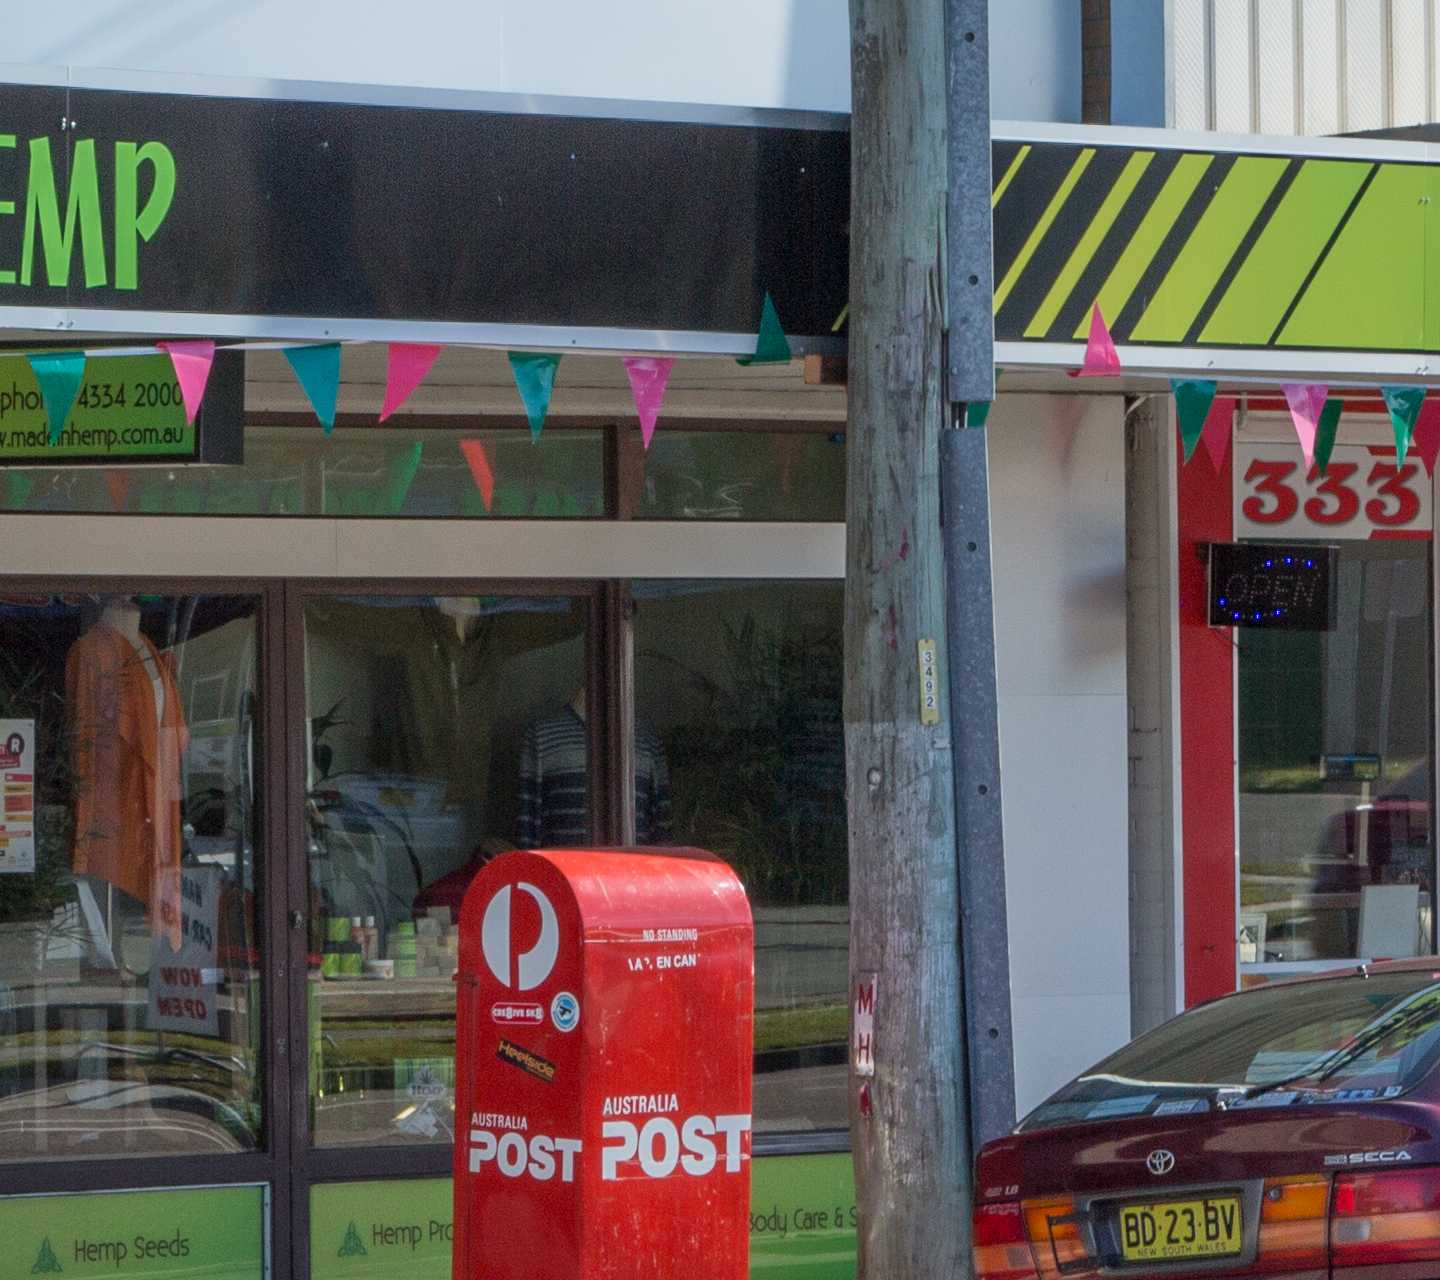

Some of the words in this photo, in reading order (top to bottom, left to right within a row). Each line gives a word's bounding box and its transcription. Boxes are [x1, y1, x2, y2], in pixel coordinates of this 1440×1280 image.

[78, 384, 127, 408] 4334
[1241, 457, 1421, 527] 333
[1225, 574, 1317, 607] OPEN
[657, 928, 698, 941] STANDING
[602, 1094, 679, 1116] AUSTRALIA
[471, 1112, 528, 1131] AUSTRALIA
[469, 1130, 583, 1182] POST
[601, 1114, 752, 1181] POST
[1349, 1150, 1412, 1164] SECA
[793, 1208, 829, 1230] Care
[834, 1207, 844, 1228] &
[73, 1237, 127, 1268] Hemp
[133, 1229, 190, 1259] Seeds
[372, 1223, 423, 1251] Hemp
[1137, 1247, 1157, 1258] NEW
[1162, 1245, 1192, 1256] SOUTH
[1196, 1242, 1227, 1253] WALES
